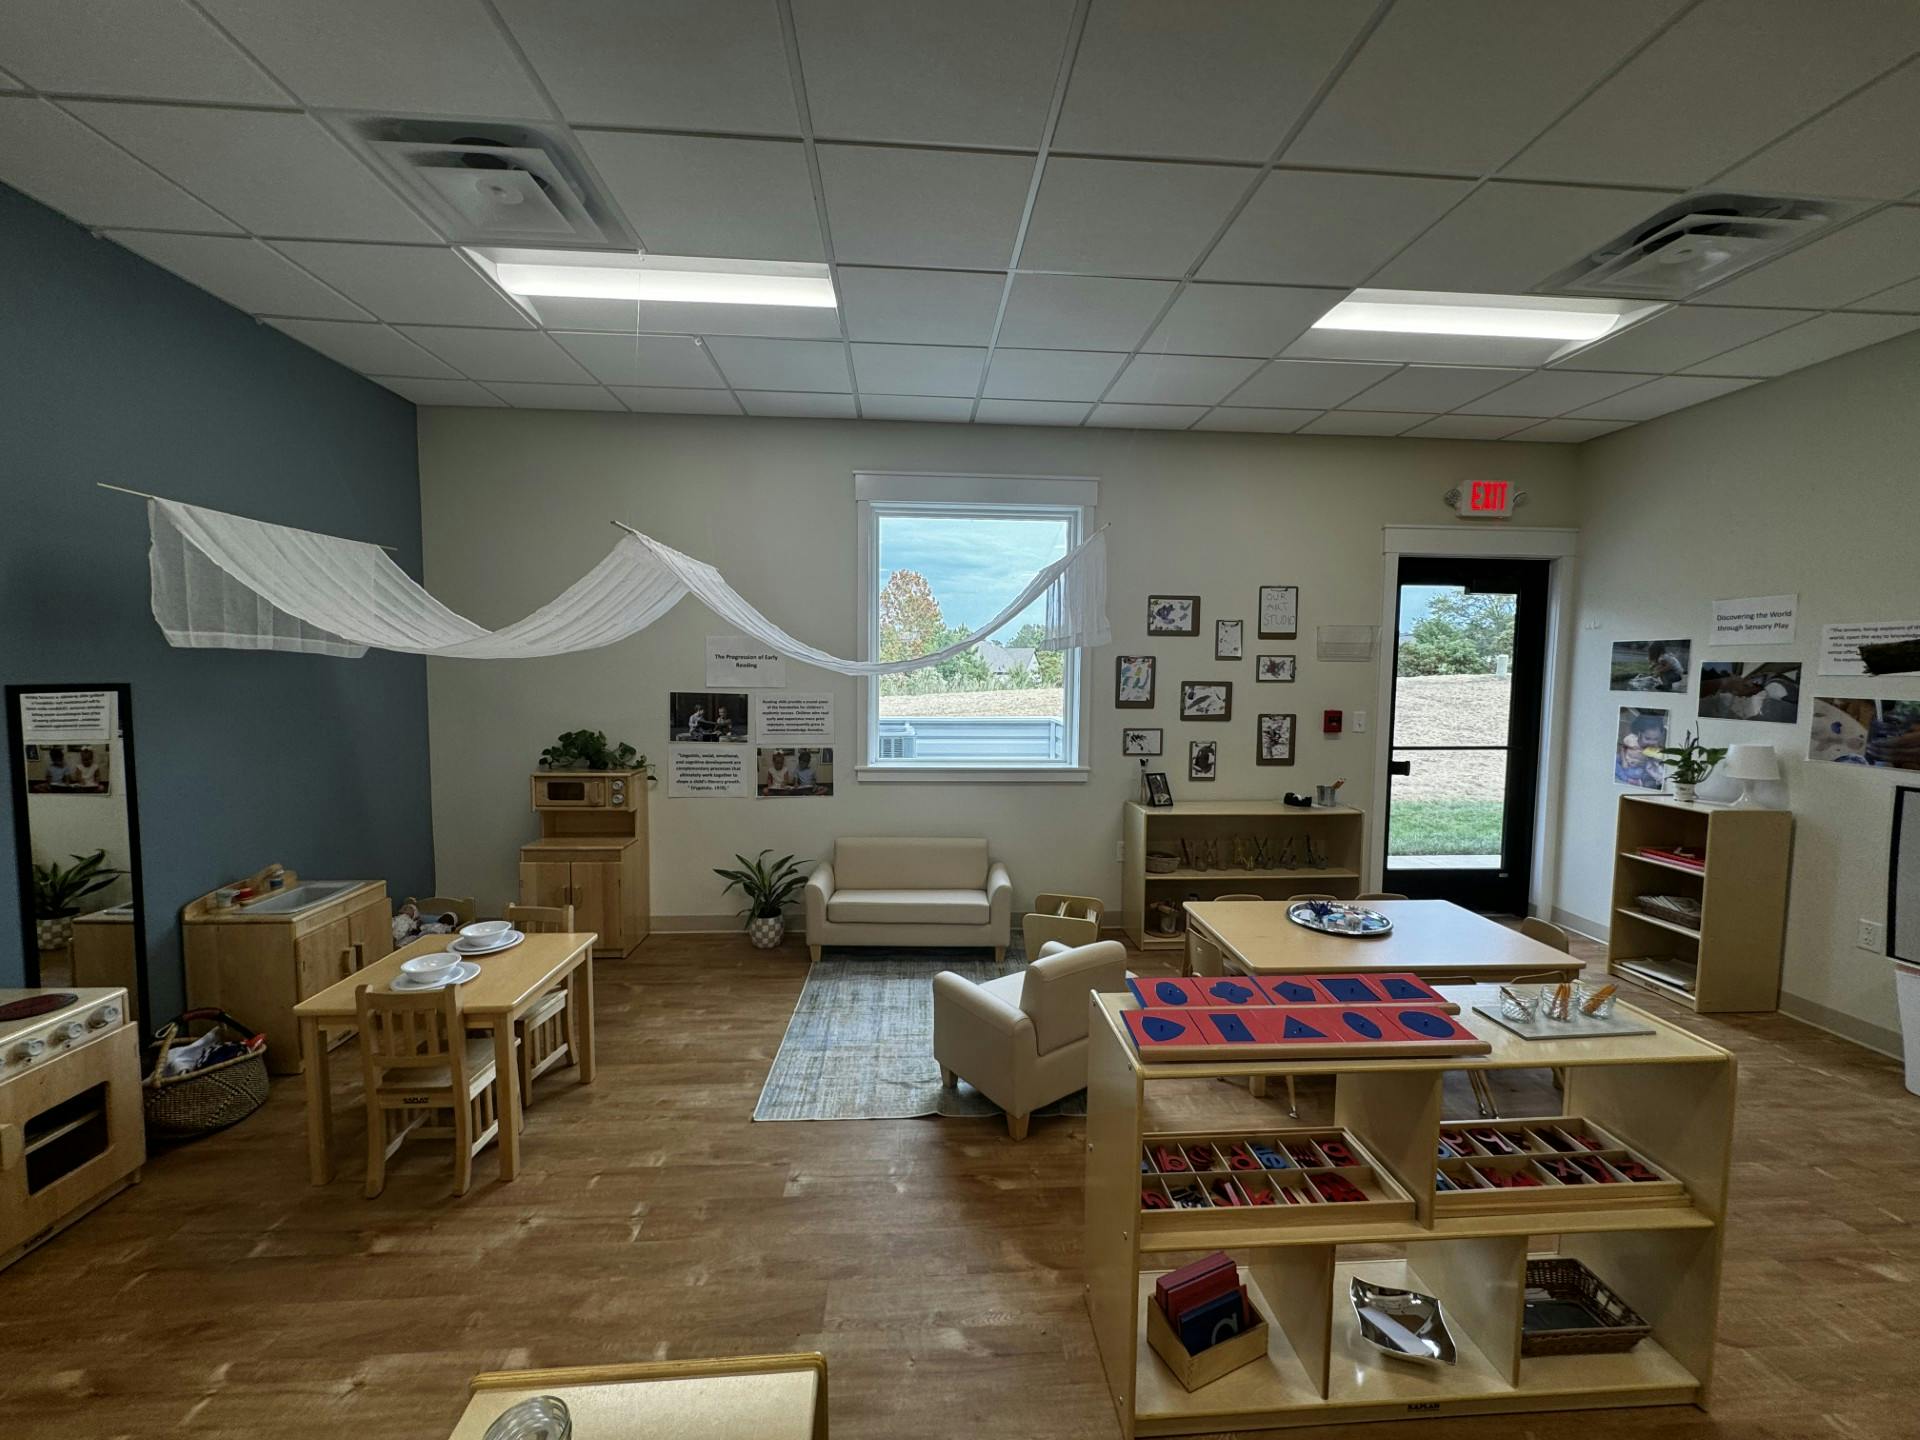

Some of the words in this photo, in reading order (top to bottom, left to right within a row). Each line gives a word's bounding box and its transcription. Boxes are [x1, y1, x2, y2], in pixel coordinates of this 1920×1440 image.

[1472, 481, 1507, 510] EXIT
[1267, 602, 1288, 610] ART
[1264, 613, 1295, 626] STUDIO
[1756, 611, 1768, 619] the
[1717, 624, 1744, 632] through
[1745, 623, 1772, 631] Sensory
[1774, 622, 1790, 630] Play
